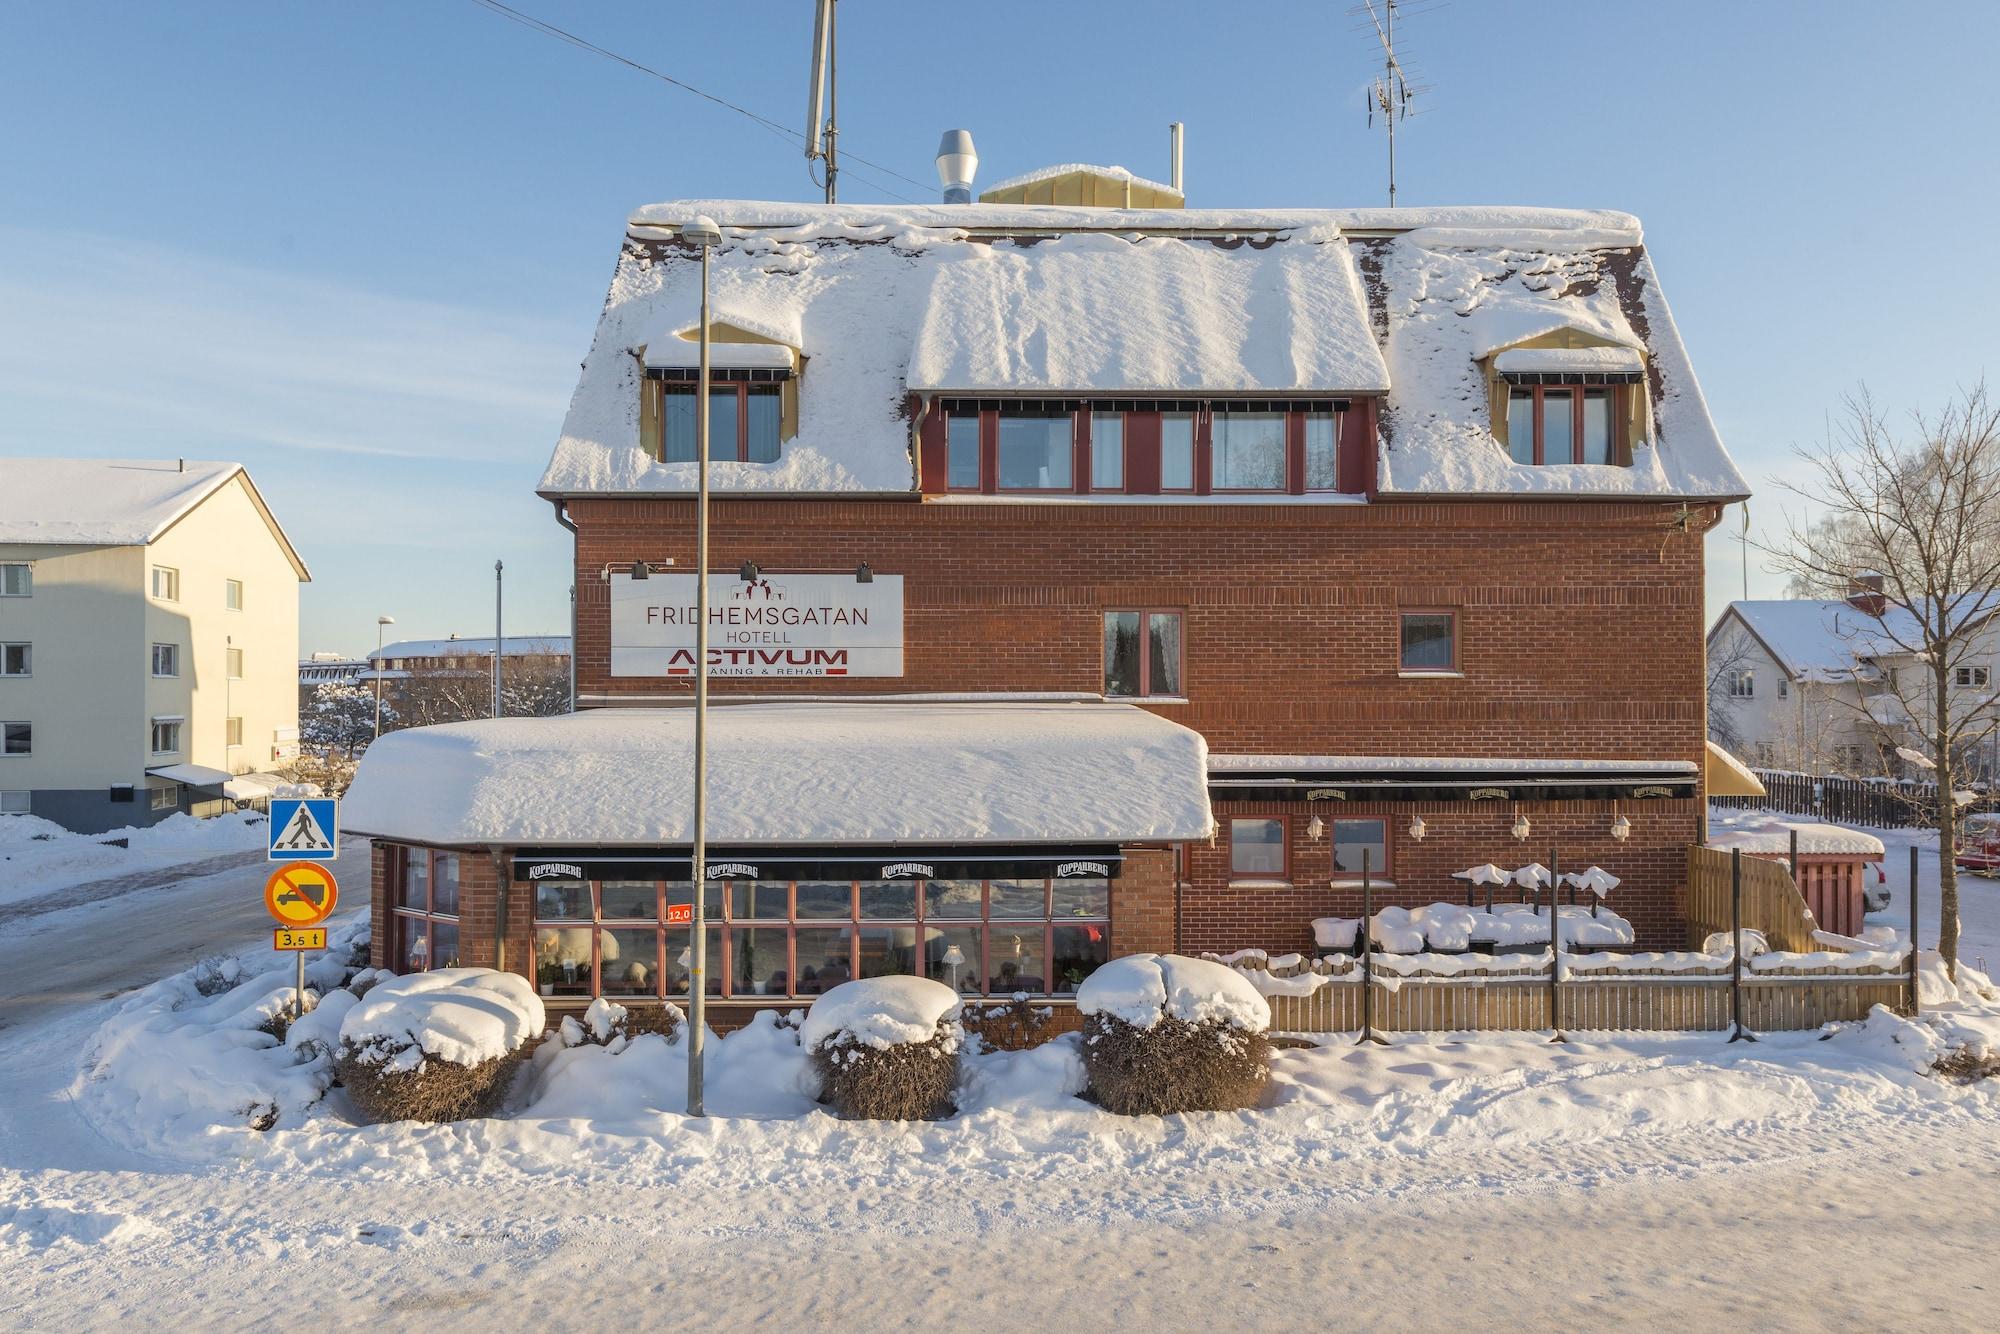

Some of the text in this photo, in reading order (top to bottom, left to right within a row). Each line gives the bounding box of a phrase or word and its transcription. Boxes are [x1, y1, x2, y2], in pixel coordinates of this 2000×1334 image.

[647, 606, 868, 625] FRIDHEMSGATAN
[727, 631, 792, 643] HOTELL
[668, 649, 848, 665] ACTIVUM
[692, 667, 753, 675] TÄNING
[529, 863, 582, 879] KOPPARBERG
[706, 863, 758, 879] KOPPARBERG
[881, 862, 934, 879] KOPPARBERG
[1057, 861, 1109, 877] KOPPARBERG
[313, 933, 318, 945] t
